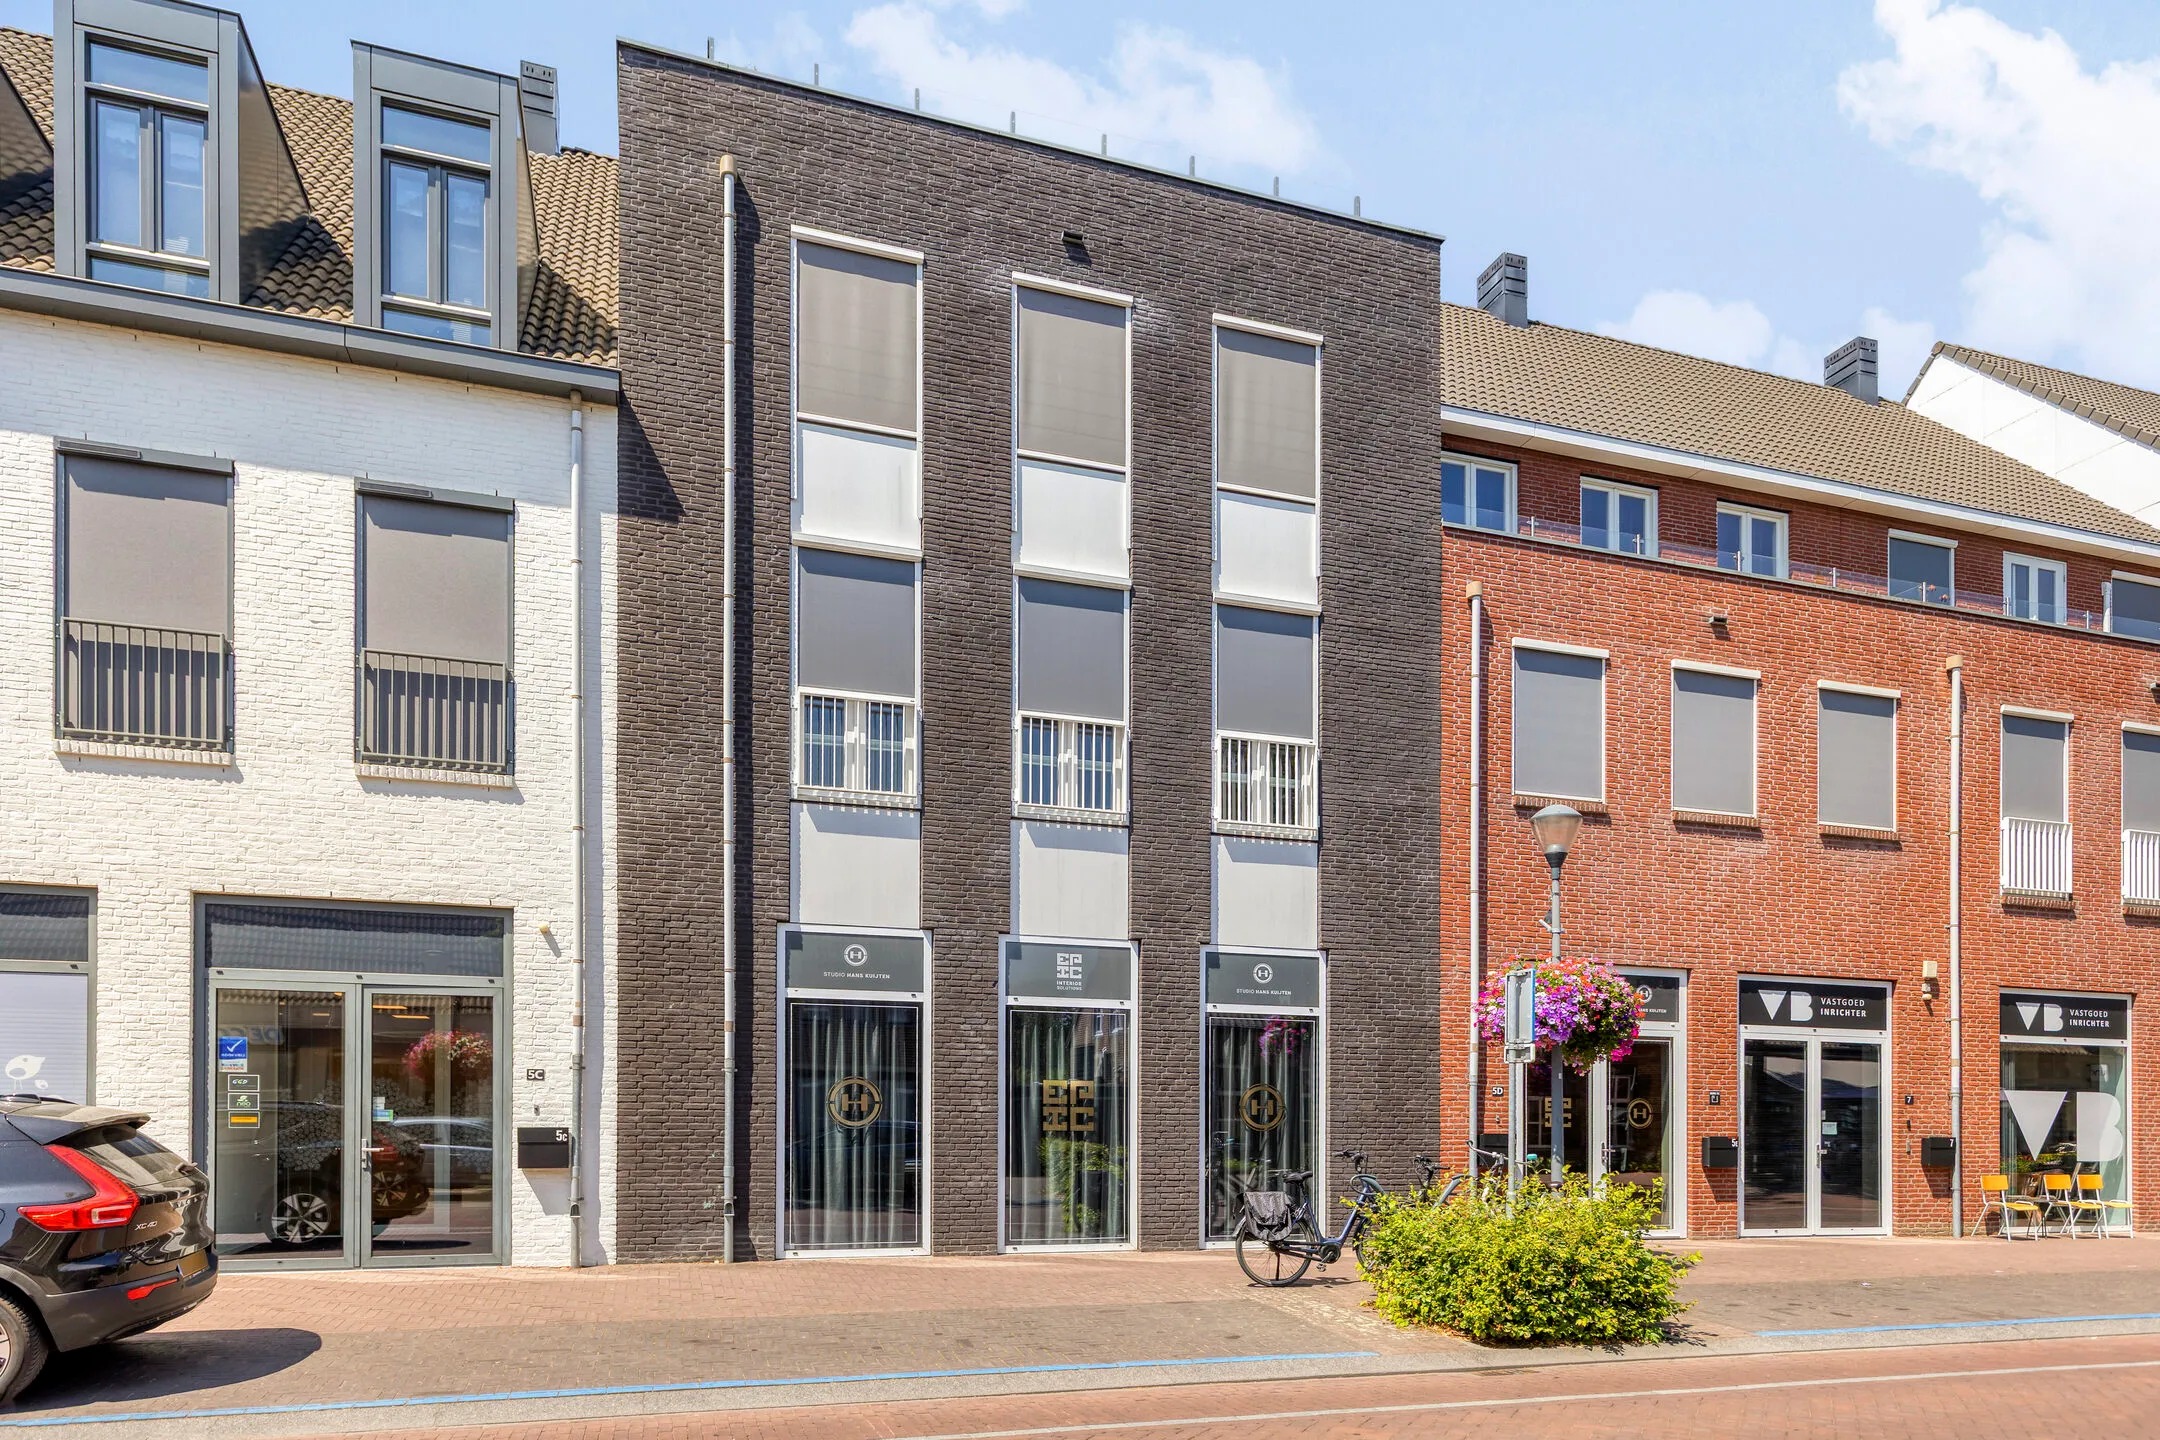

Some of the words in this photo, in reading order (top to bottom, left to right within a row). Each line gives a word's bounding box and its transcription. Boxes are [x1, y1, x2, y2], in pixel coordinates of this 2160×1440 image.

[1820, 997, 1865, 1007] VASTGOED
[1820, 1007, 1867, 1018] INRICHTER
[2069, 1008, 2108, 1018] VASTGOED
[2069, 1018, 2110, 1028] INRICHTER
[528, 1070, 543, 1079] 5C
[1492, 1087, 1504, 1095] 5D
[1907, 1096, 1912, 1104] 7
[1950, 1139, 1954, 1147] 7
